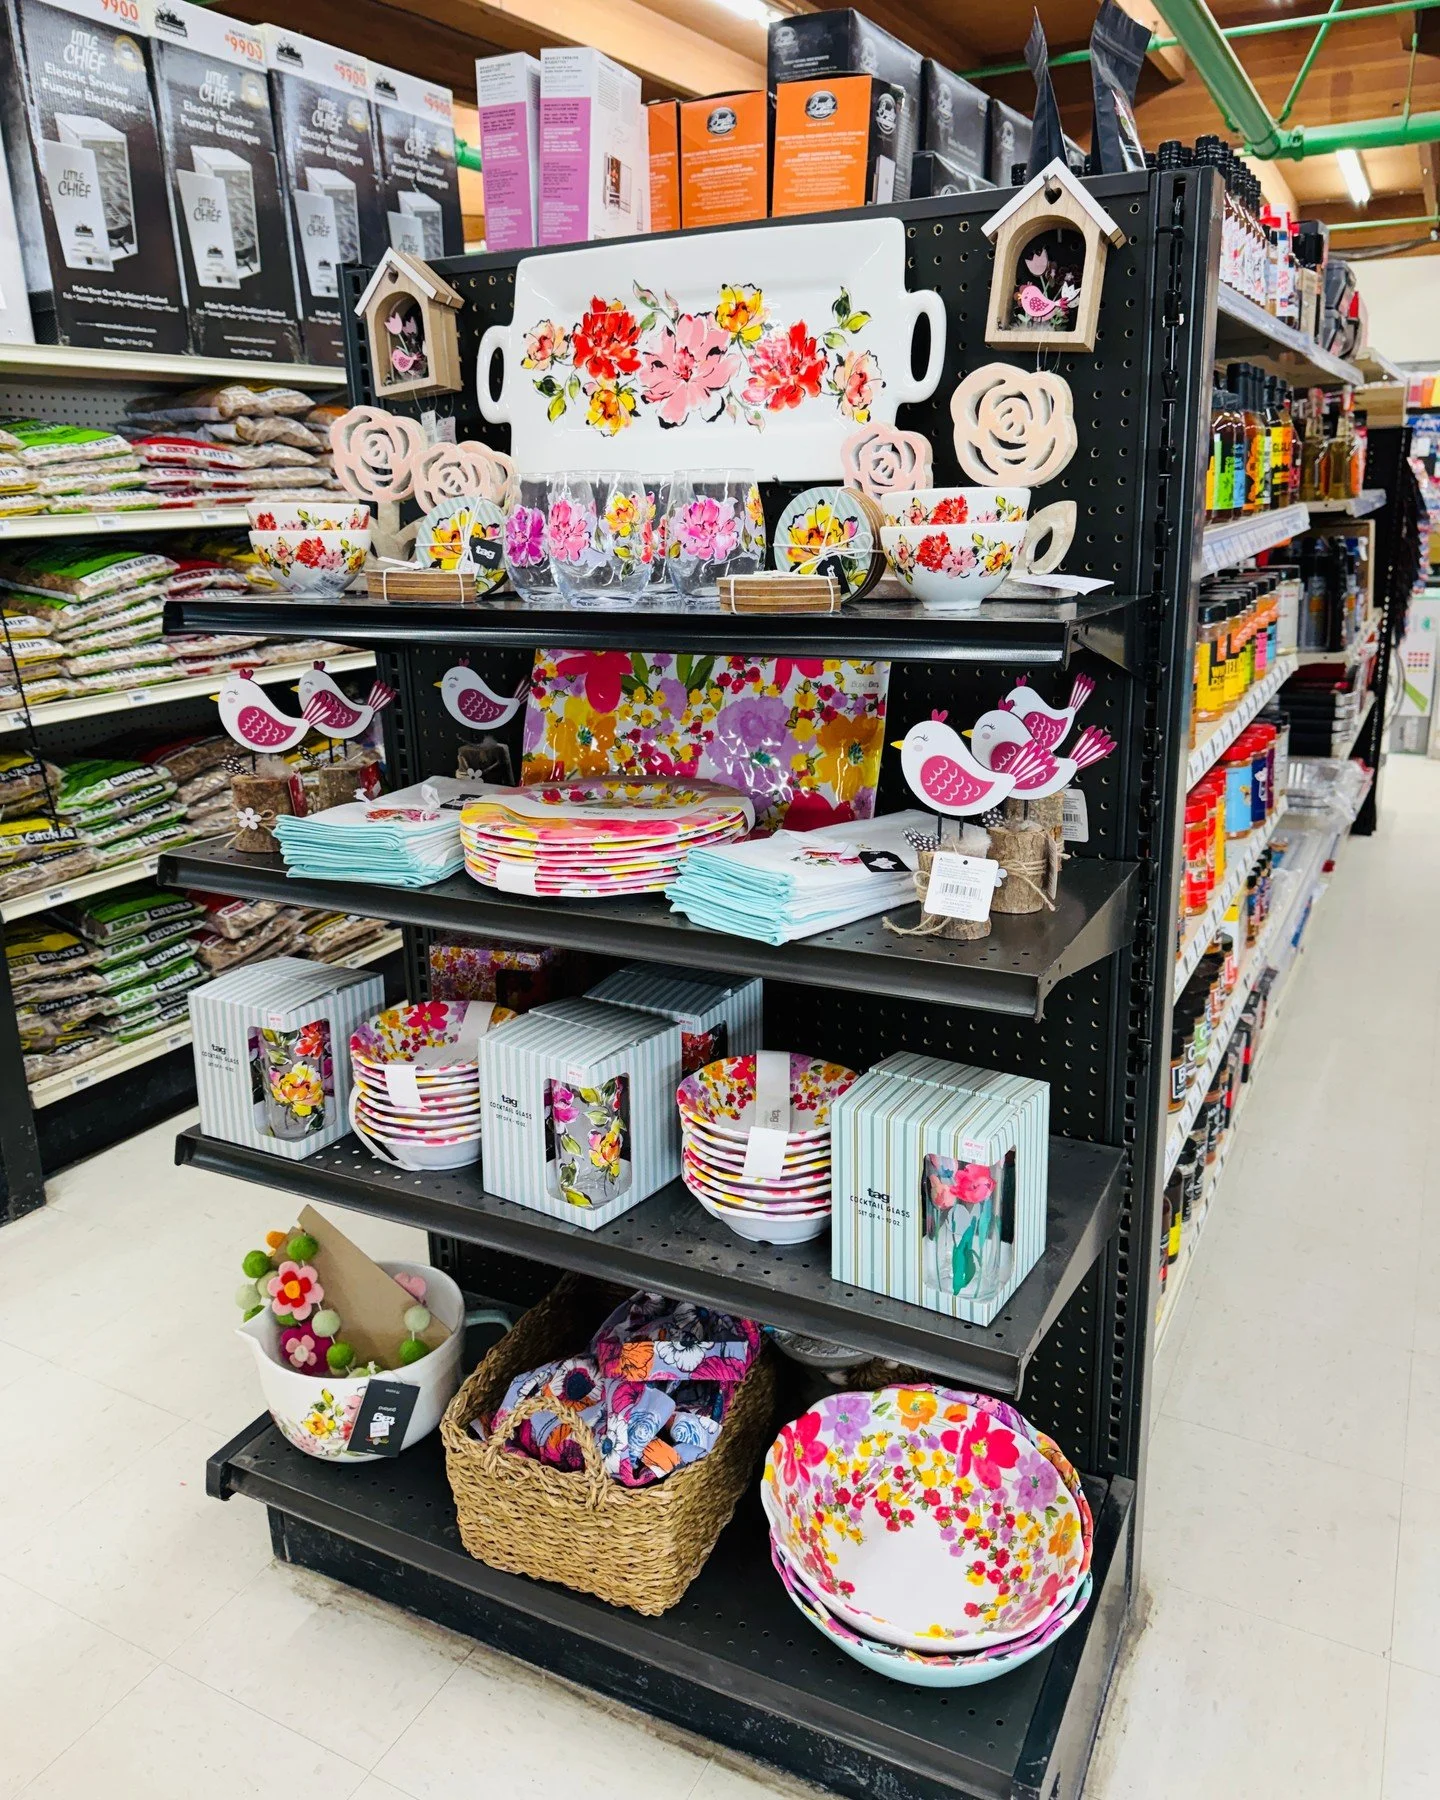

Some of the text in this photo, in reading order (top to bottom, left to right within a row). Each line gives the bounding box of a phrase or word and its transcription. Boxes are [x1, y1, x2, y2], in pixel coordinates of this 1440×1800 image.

[71, 29, 99, 50] LITTLE
[63, 44, 107, 74] CHIEF
[41, 77, 82, 99] Fumoir
[44, 61, 129, 96] Electric Smoker
[199, 83, 236, 110] CHIEF
[180, 113, 215, 133] Fumoir
[183, 99, 255, 129] Electric Smoker
[311, 109, 343, 134] CHIEF
[404, 138, 431, 160] CHIEF
[63, 168, 84, 182] LITTLE
[58, 181, 91, 199] CHIEF
[193, 207, 222, 223] CHIEF
[306, 224, 331, 238] CHIEF
[476, 545, 496, 560] tag
[150, 902, 194, 919] CHUNKS
[148, 919, 192, 942] CHUNKS
[156, 965, 200, 991] CHUNKS
[211, 1044, 226, 1055] tag
[489, 1101, 532, 1120] COCKTAIL GLASS
[501, 1094, 518, 1108] tag
[770, 1109, 781, 1123] tag
[867, 1188, 890, 1204] tag
[849, 1195, 910, 1218] COCKTAIL GLASS
[372, 1412, 396, 1426] tag
